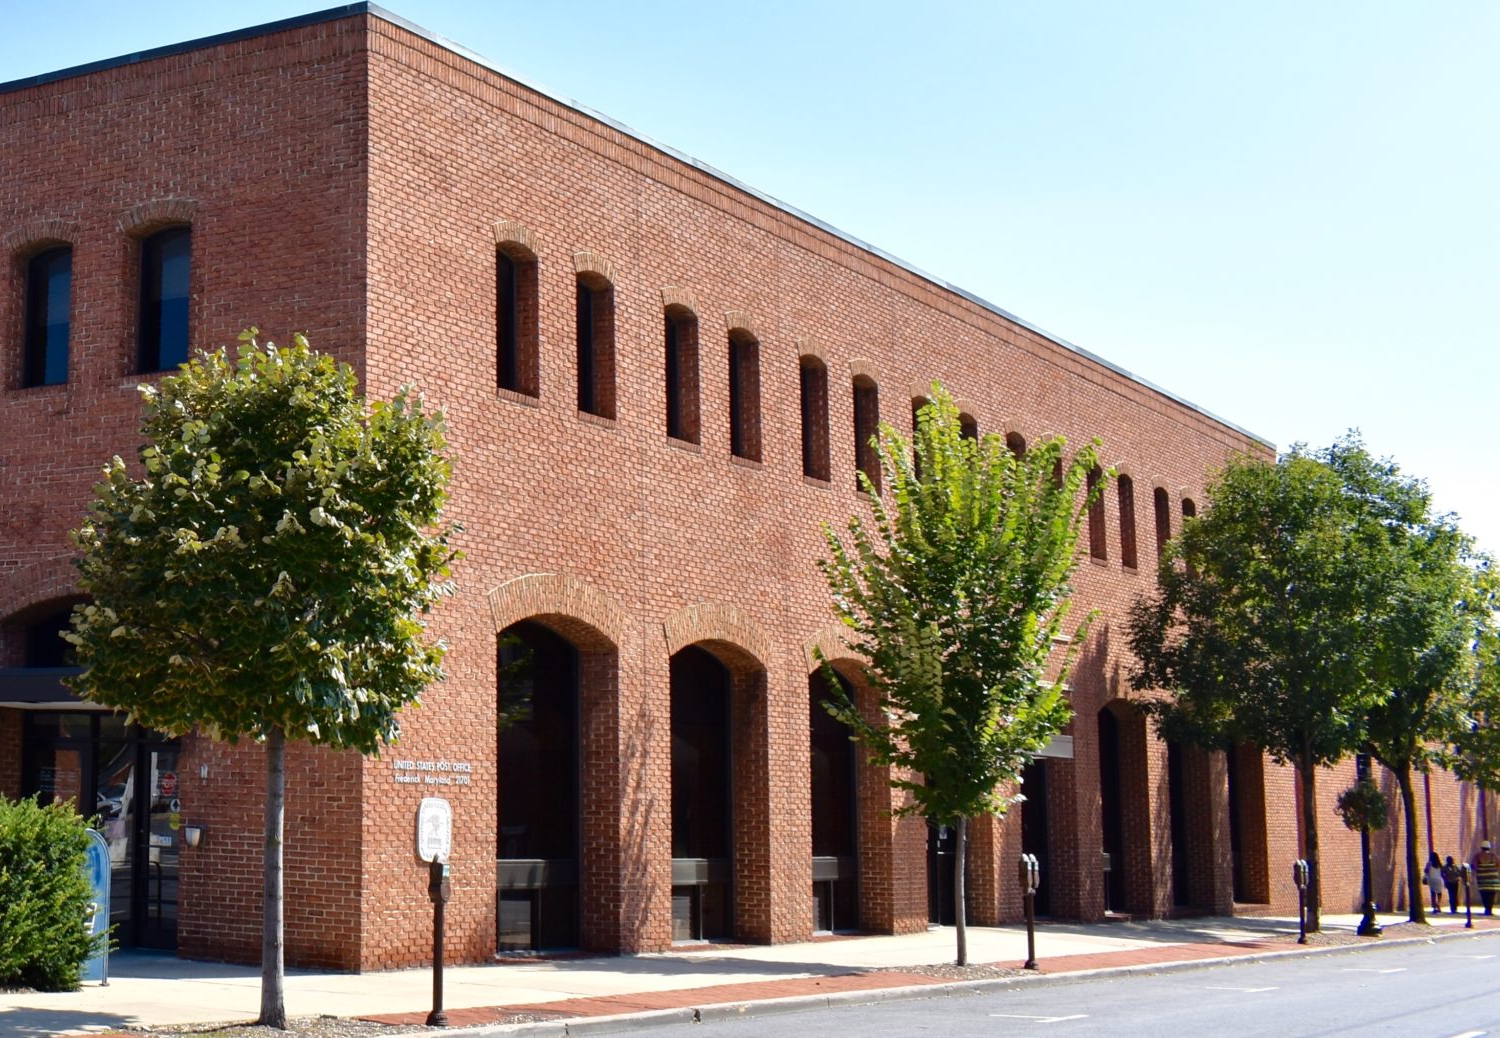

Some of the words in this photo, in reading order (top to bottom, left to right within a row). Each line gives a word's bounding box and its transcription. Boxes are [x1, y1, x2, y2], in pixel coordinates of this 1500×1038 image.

[393, 760, 414, 770] UNITED
[416, 761, 434, 771] STATES
[436, 762, 450, 771] POST
[452, 763, 471, 773] OFFICE
[424, 775, 451, 786] Maryland
